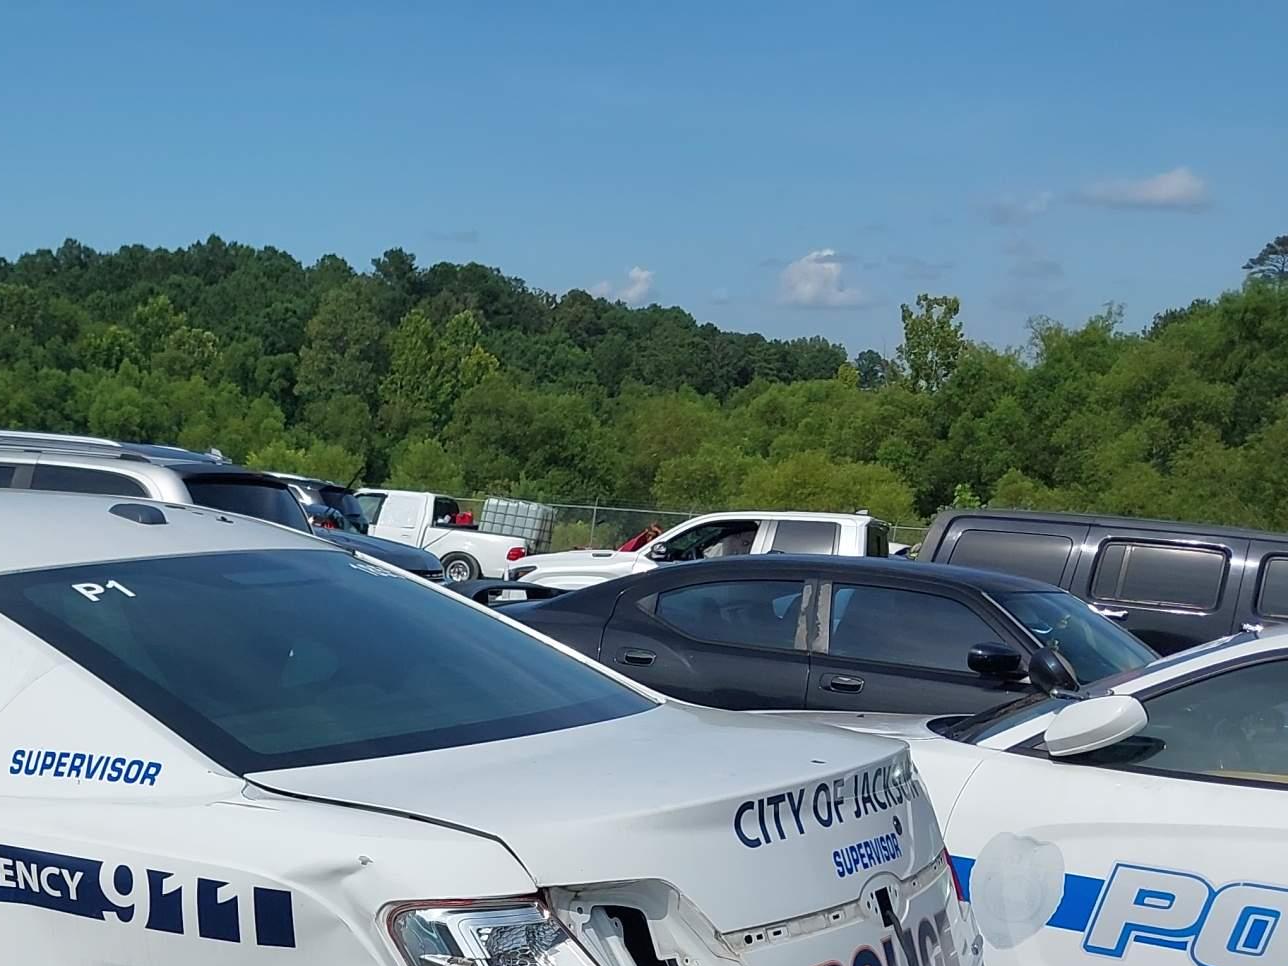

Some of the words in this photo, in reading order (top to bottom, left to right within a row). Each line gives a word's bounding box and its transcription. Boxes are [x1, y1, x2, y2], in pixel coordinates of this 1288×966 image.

[72, 580, 137, 602] P1
[9, 749, 162, 787] SUPERVISOR
[733, 788, 806, 849] CITY
[812, 779, 845, 828] OF
[832, 832, 903, 878] SUPERVISOR
[99, 857, 264, 945] 911
